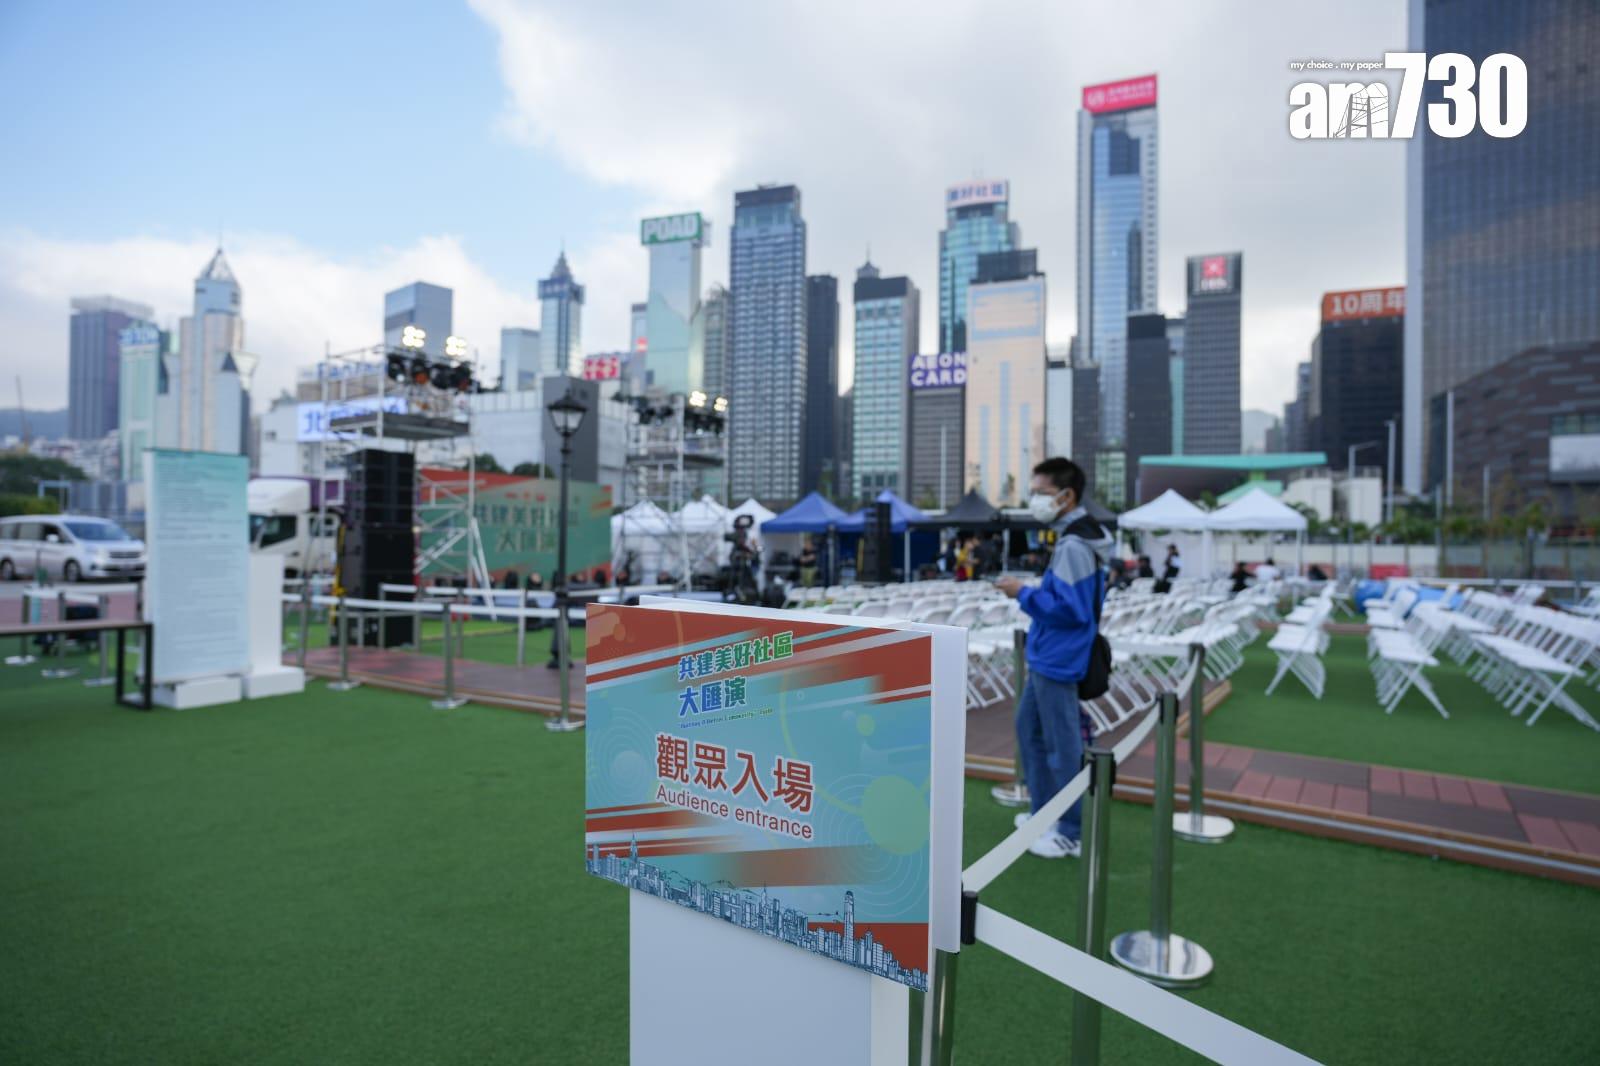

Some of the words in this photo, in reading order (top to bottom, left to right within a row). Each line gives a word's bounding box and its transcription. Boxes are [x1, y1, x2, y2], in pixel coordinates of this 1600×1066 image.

[643, 214, 699, 243] POAD
[911, 352, 967, 369] AEON
[911, 368, 966, 386] CARD
[679, 632, 793, 680] 共建美好社區
[679, 676, 746, 717] 大匯演
[657, 734, 814, 813] 觀眾入場
[656, 784, 729, 817] Audience
[735, 807, 813, 840] entrance
